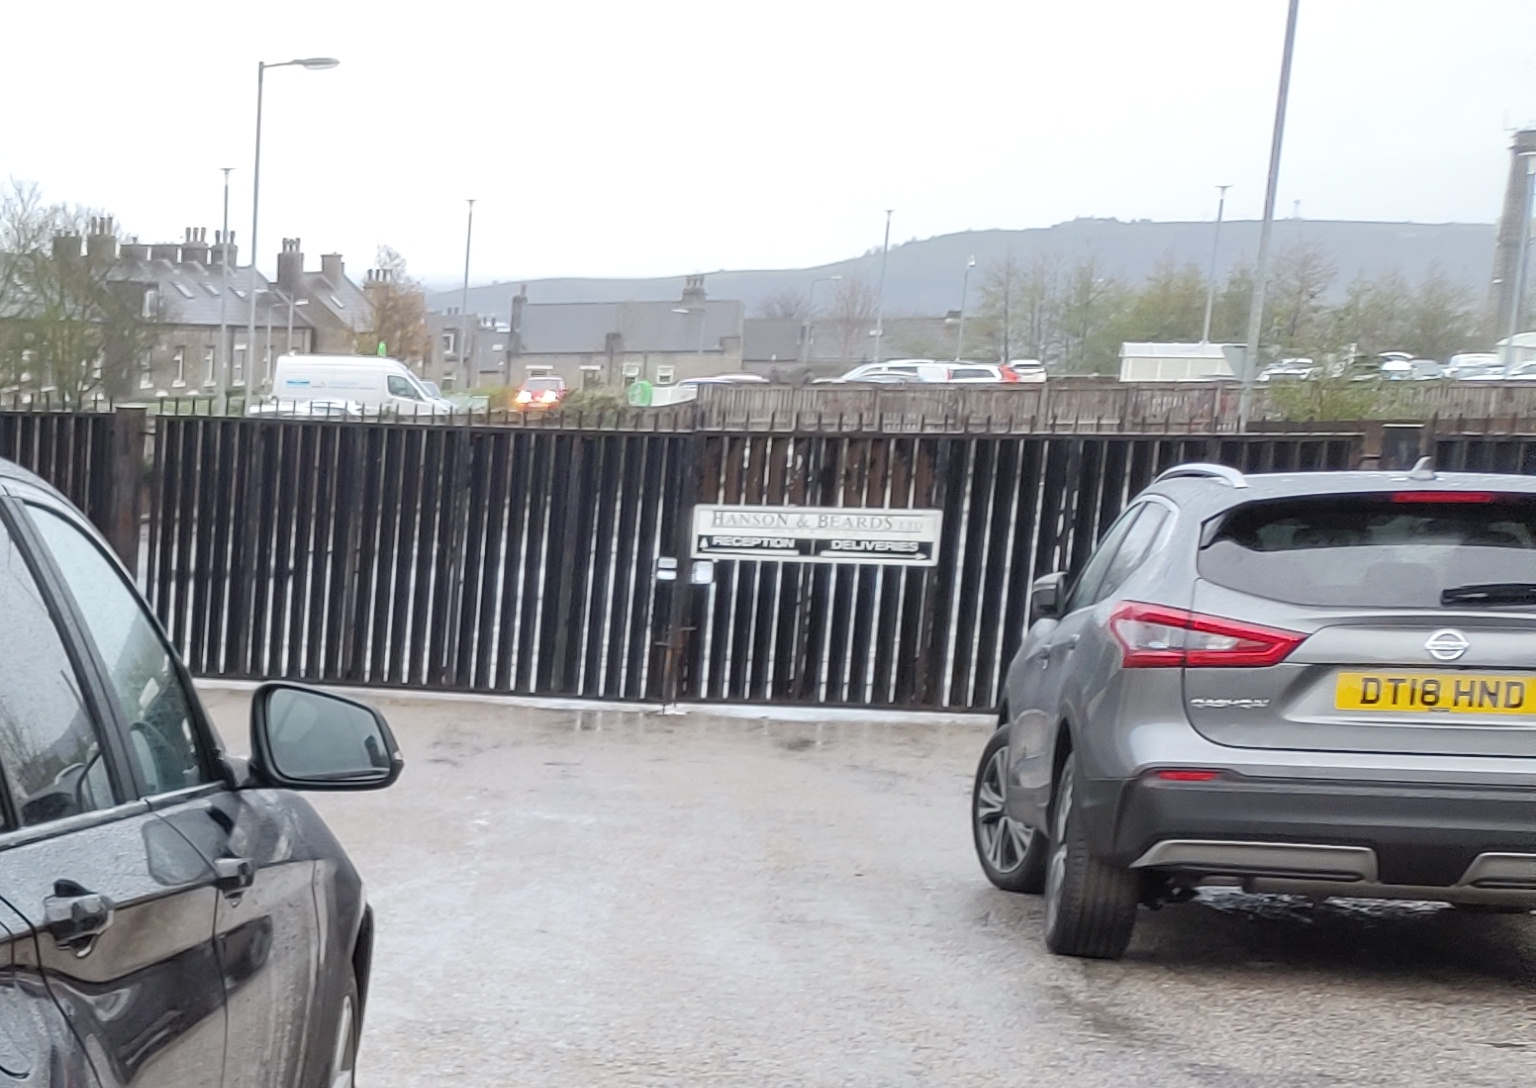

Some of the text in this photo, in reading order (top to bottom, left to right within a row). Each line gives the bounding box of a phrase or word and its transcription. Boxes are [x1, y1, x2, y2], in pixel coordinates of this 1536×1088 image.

[711, 511, 788, 528] HANSON
[796, 515, 810, 527] &
[817, 515, 894, 530] BEARDS
[712, 535, 795, 549] RECEPTION
[831, 539, 919, 553] DELIVERIES
[1360, 677, 1525, 709] DT18 HND
